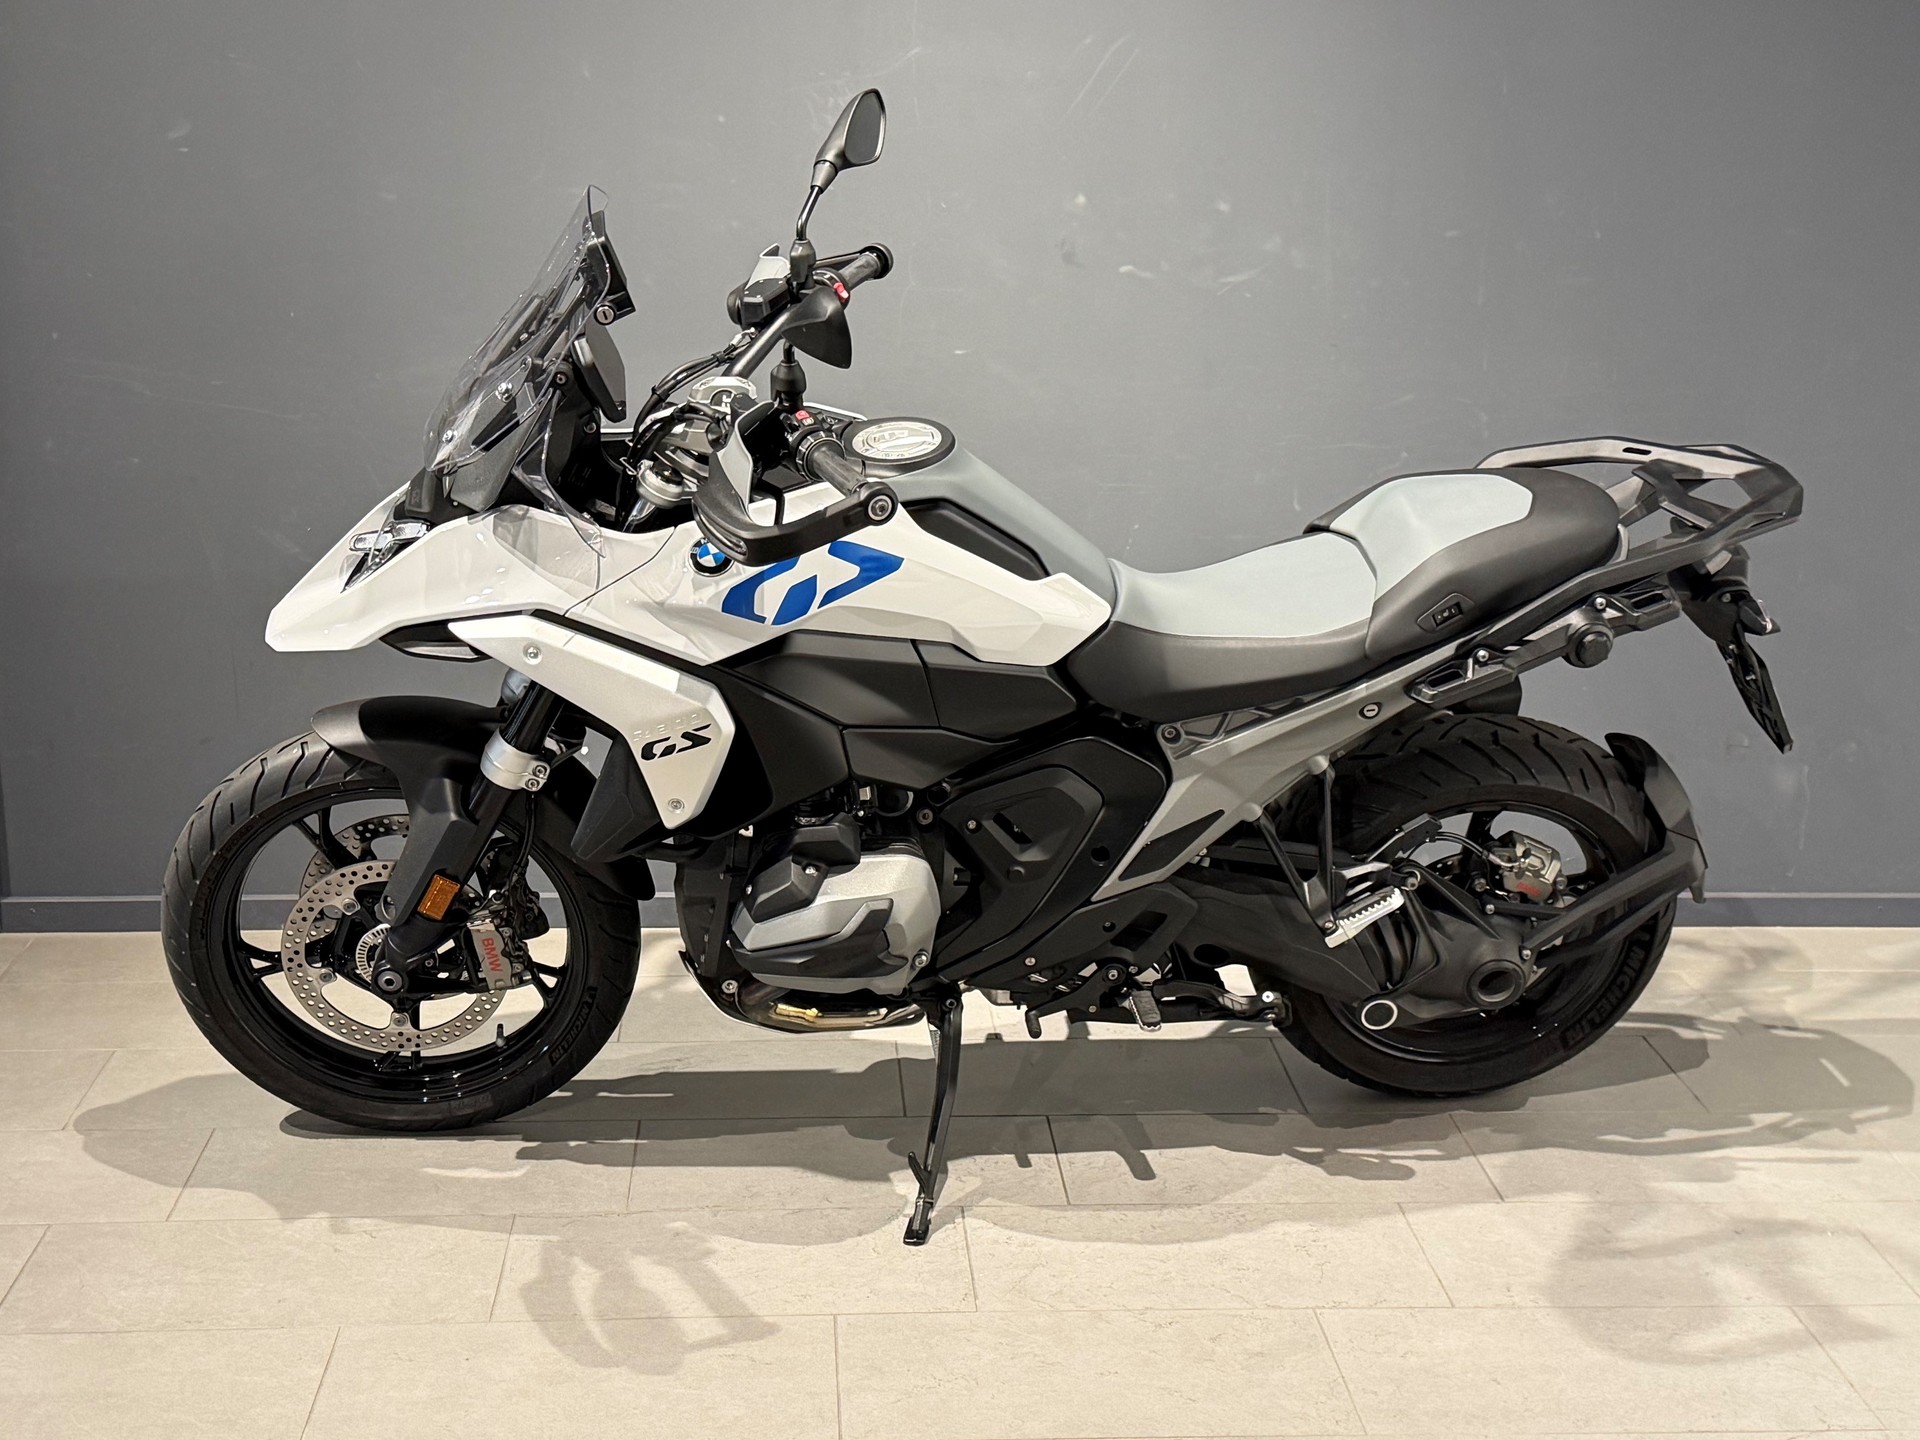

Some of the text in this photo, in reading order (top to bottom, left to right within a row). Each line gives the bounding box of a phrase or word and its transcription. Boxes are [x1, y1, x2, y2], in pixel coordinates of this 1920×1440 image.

[641, 723, 712, 761] GS
[482, 937, 503, 972] BMW
[1565, 945, 1645, 1044] MICHELIN
[551, 1003, 590, 1062] MICHELIN
